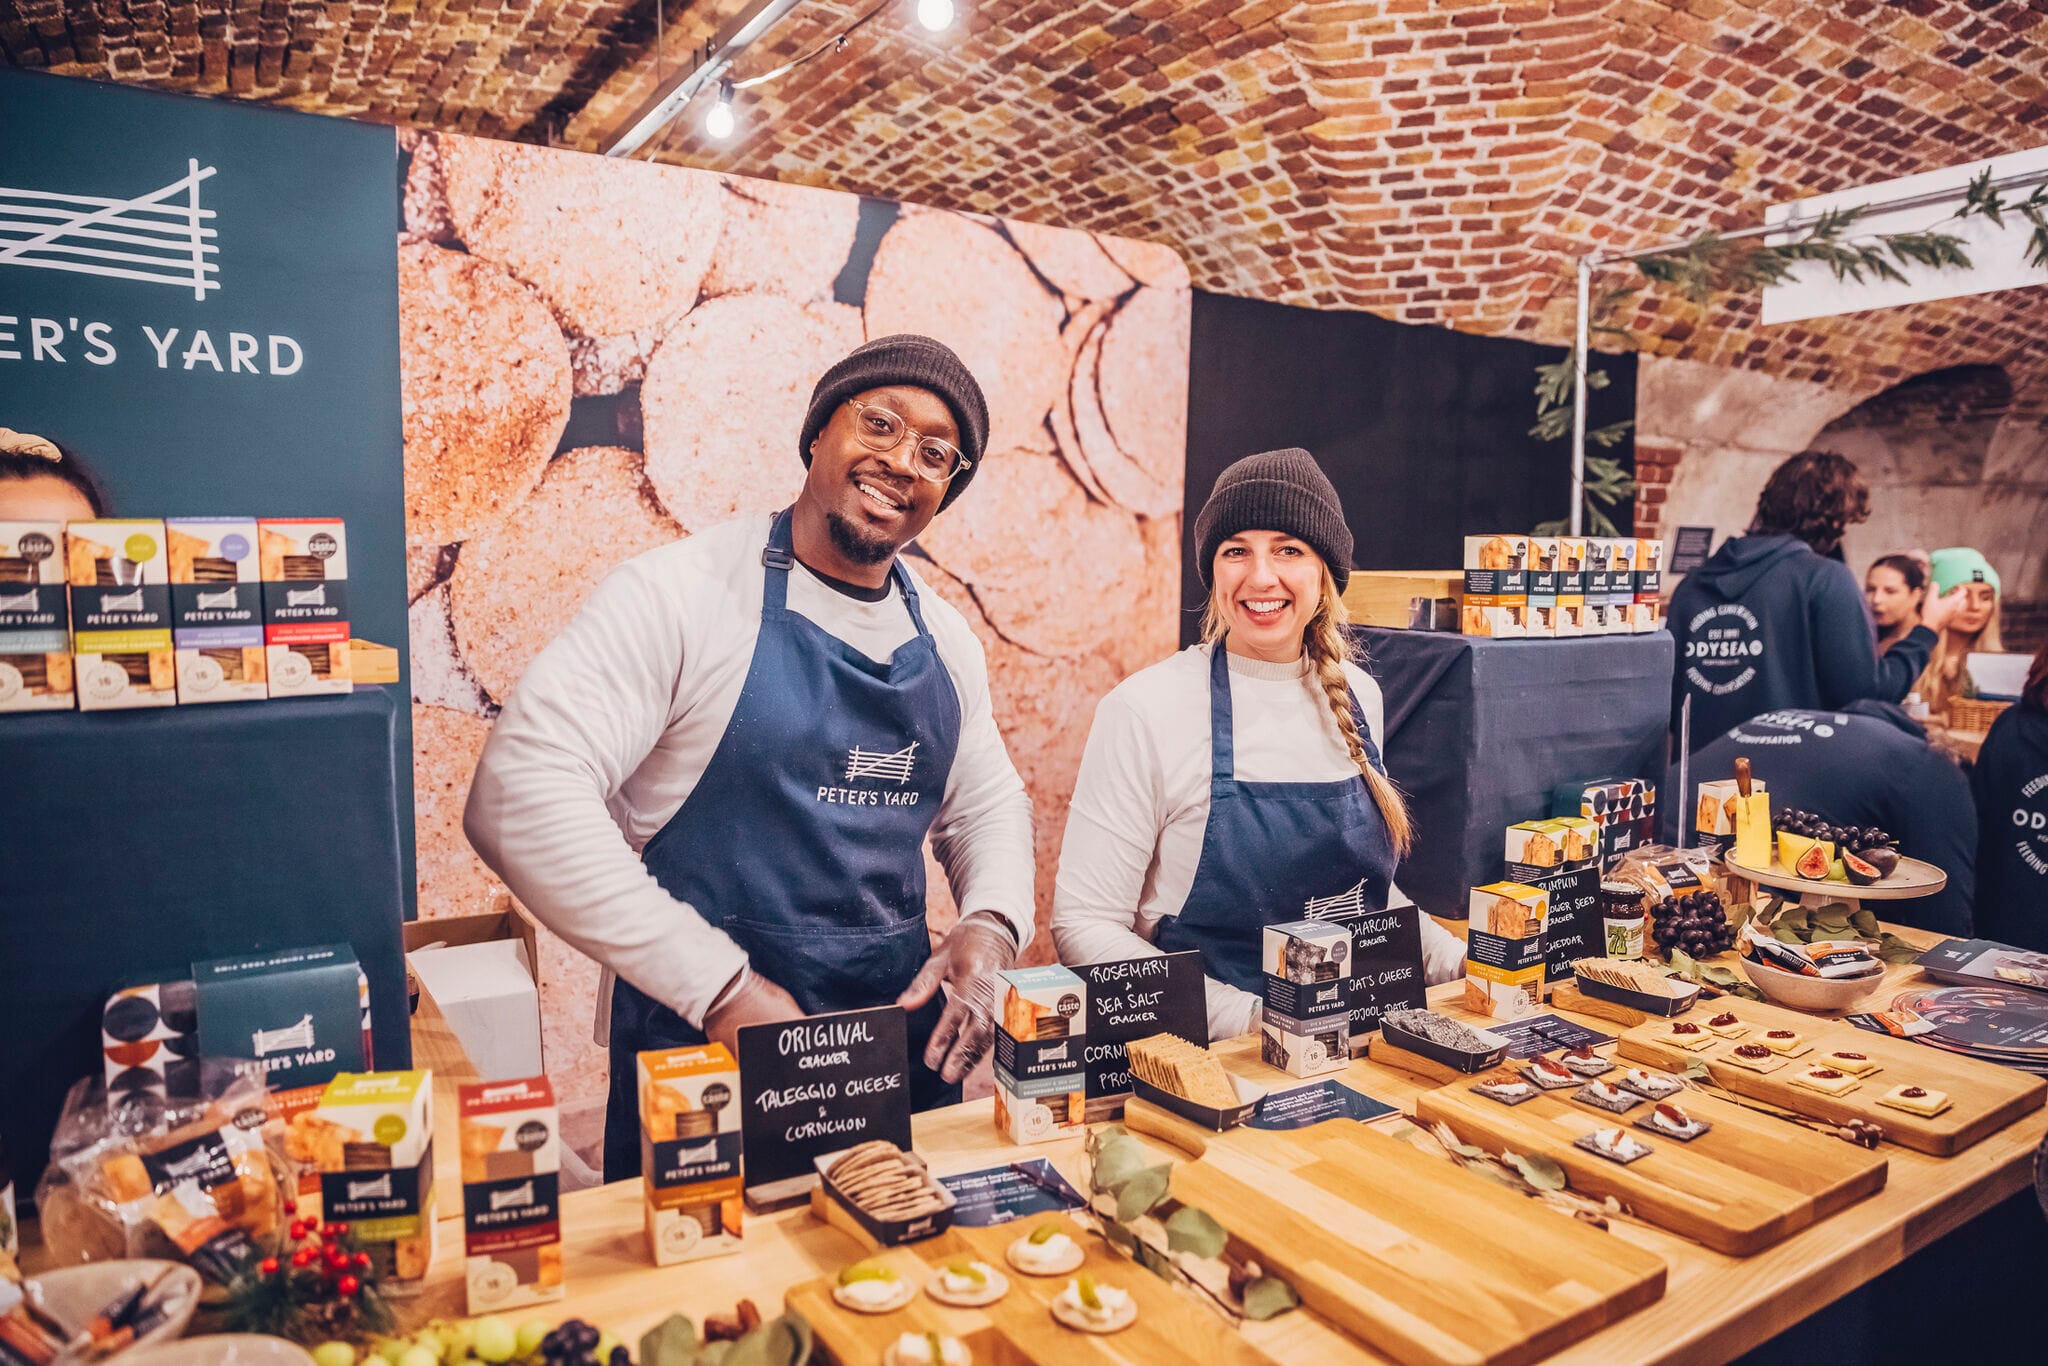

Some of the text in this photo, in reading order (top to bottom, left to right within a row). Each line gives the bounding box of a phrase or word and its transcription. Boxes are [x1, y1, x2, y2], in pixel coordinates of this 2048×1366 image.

[142, 325, 304, 376] YARD
[87, 613, 159, 625] PETER'S YARD
[184, 610, 251, 622] PETER'S YARD
[275, 607, 338, 618] PETER'S YARD
[817, 786, 919, 806] PETER'S YARD
[2012, 808, 2047, 830] OD
[1574, 896, 1595, 910] SEED
[1347, 916, 1402, 939] CHARCOAL
[1358, 935, 1388, 948] CRACKER
[1545, 935, 1584, 953] CHEDDAR
[1089, 960, 1169, 984] ROSEMARY
[1378, 967, 1413, 985] CHEESE
[1058, 1002, 1080, 1012] taste
[1096, 990, 1164, 1016] SEA SALT
[1308, 1001, 1345, 1014] PETER'S YARD
[1109, 1011, 1158, 1026] CRACKER
[778, 1021, 874, 1056] ORIGINAL
[234, 1048, 336, 1078] PETER'S YARD
[798, 1050, 851, 1069] CRACKER
[1310, 1051, 1318, 1061] 16
[1027, 1060, 1078, 1075] PETER'S YARD
[755, 1072, 902, 1113] TALEGGIO CHEESE
[1031, 1116, 1042, 1126] 16
[664, 1161, 731, 1180] PETER'S YARD
